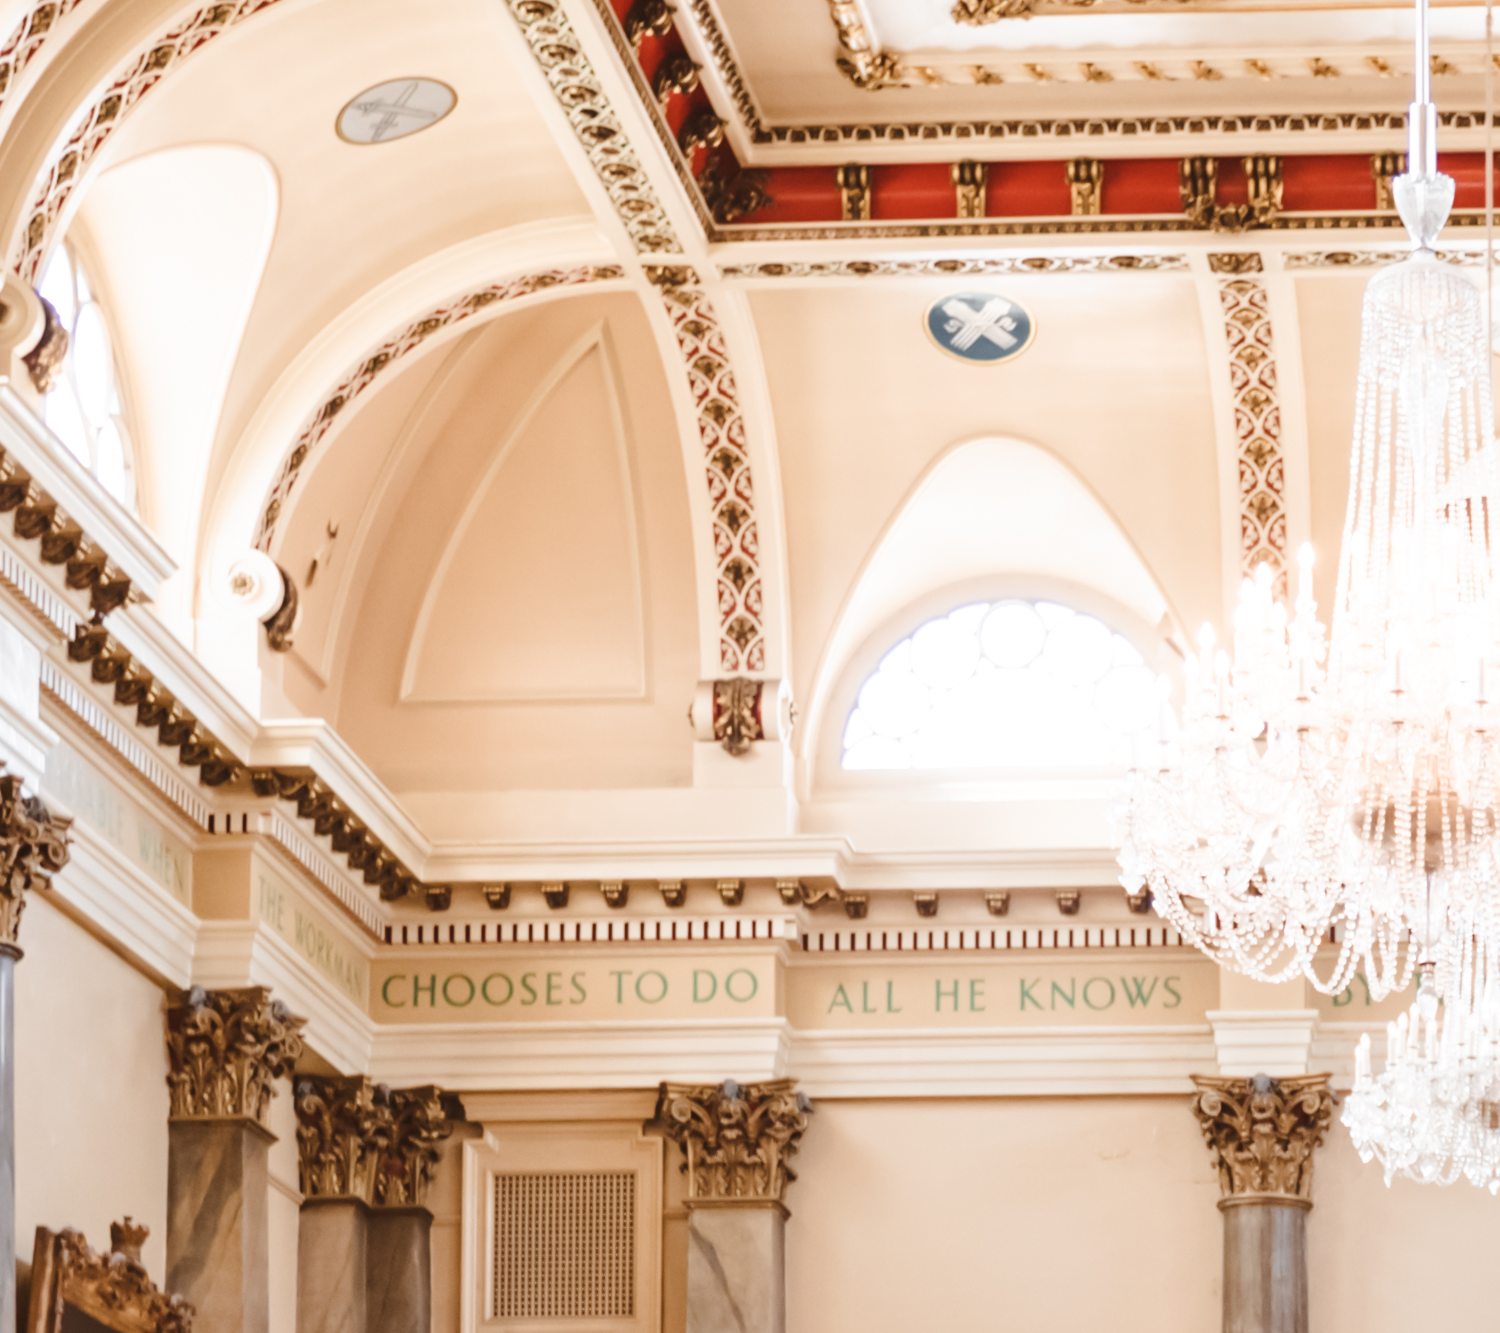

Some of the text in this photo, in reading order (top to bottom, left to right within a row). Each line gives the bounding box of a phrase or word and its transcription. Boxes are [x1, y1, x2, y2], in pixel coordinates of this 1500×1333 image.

[258, 874, 363, 998] THE WORKMAN
[381, 967, 760, 1008] CHOOSES TO DO
[826, 974, 1183, 1014] ALL HE KNOWS
